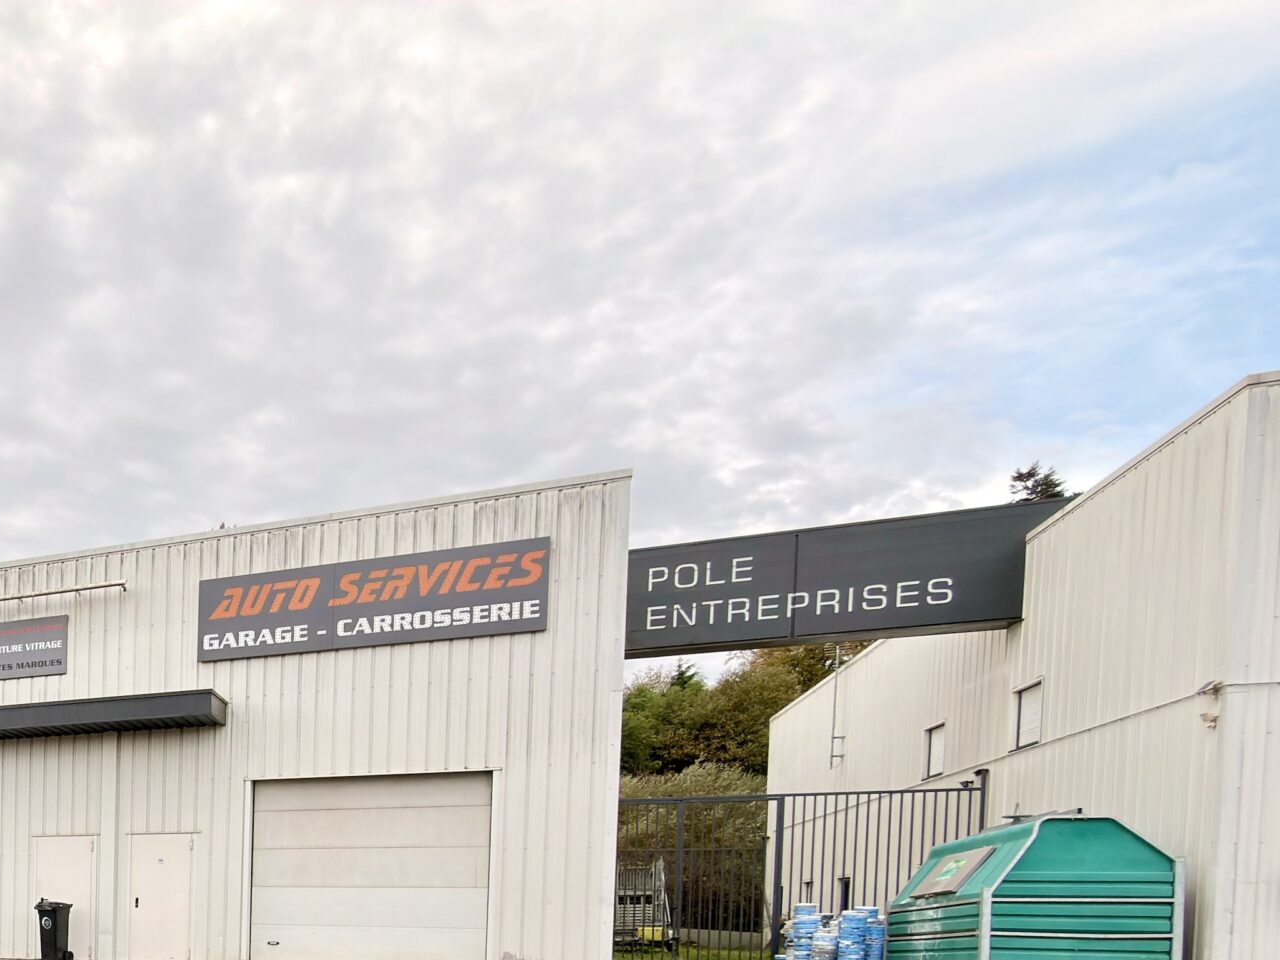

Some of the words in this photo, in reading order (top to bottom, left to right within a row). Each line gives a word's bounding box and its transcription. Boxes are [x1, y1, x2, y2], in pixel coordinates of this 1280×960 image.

[208, 577, 320, 621] AUTO
[327, 550, 546, 607] SERVICES
[647, 556, 753, 592] POLE
[203, 624, 308, 651] GARAGE
[336, 599, 541, 637] CARROSSERIE
[646, 577, 954, 630] ENTREPRISES
[16, 658, 62, 669] MARQUES
[25, 640, 62, 651] VITRAGE
